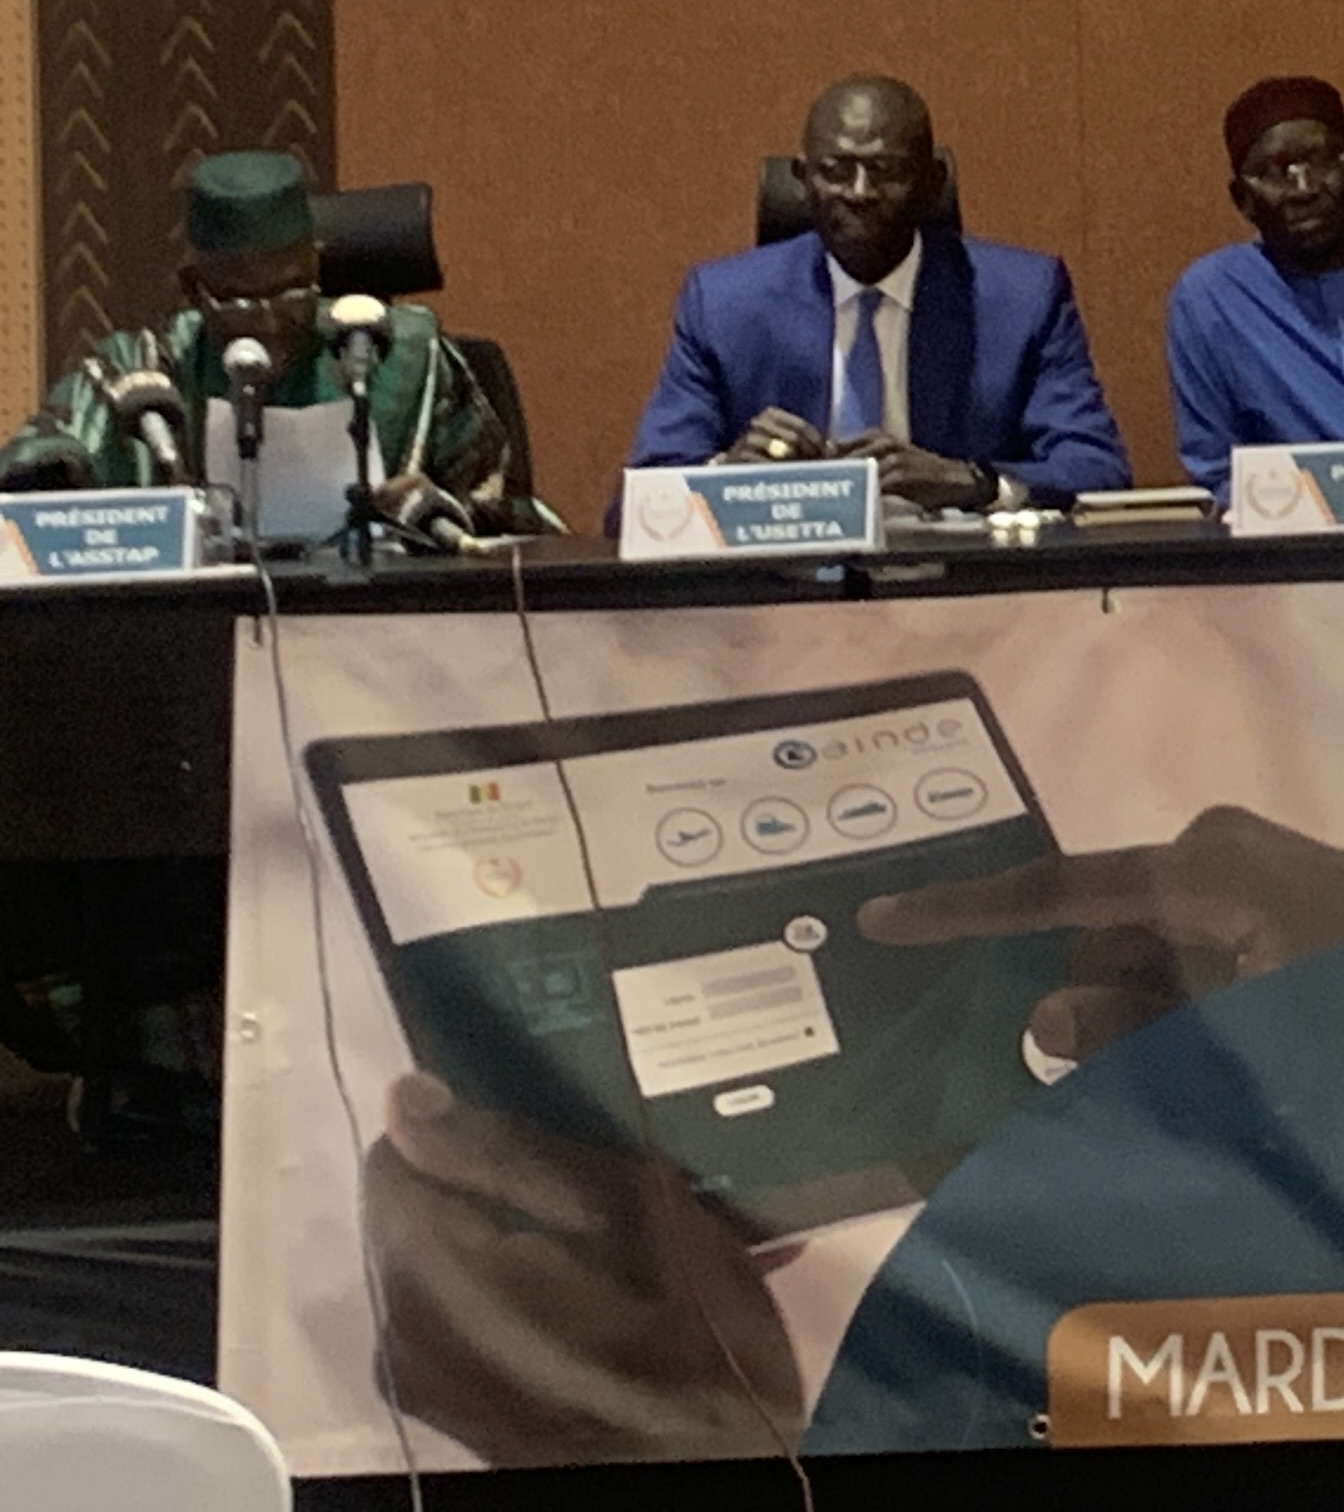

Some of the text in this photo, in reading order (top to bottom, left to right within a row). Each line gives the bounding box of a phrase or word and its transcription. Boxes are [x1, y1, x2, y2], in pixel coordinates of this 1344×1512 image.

[723, 479, 855, 502] PRÉSIDENT
[35, 504, 169, 528] PRÉSIDENT
[771, 502, 803, 521] DE
[84, 528, 118, 546] DE
